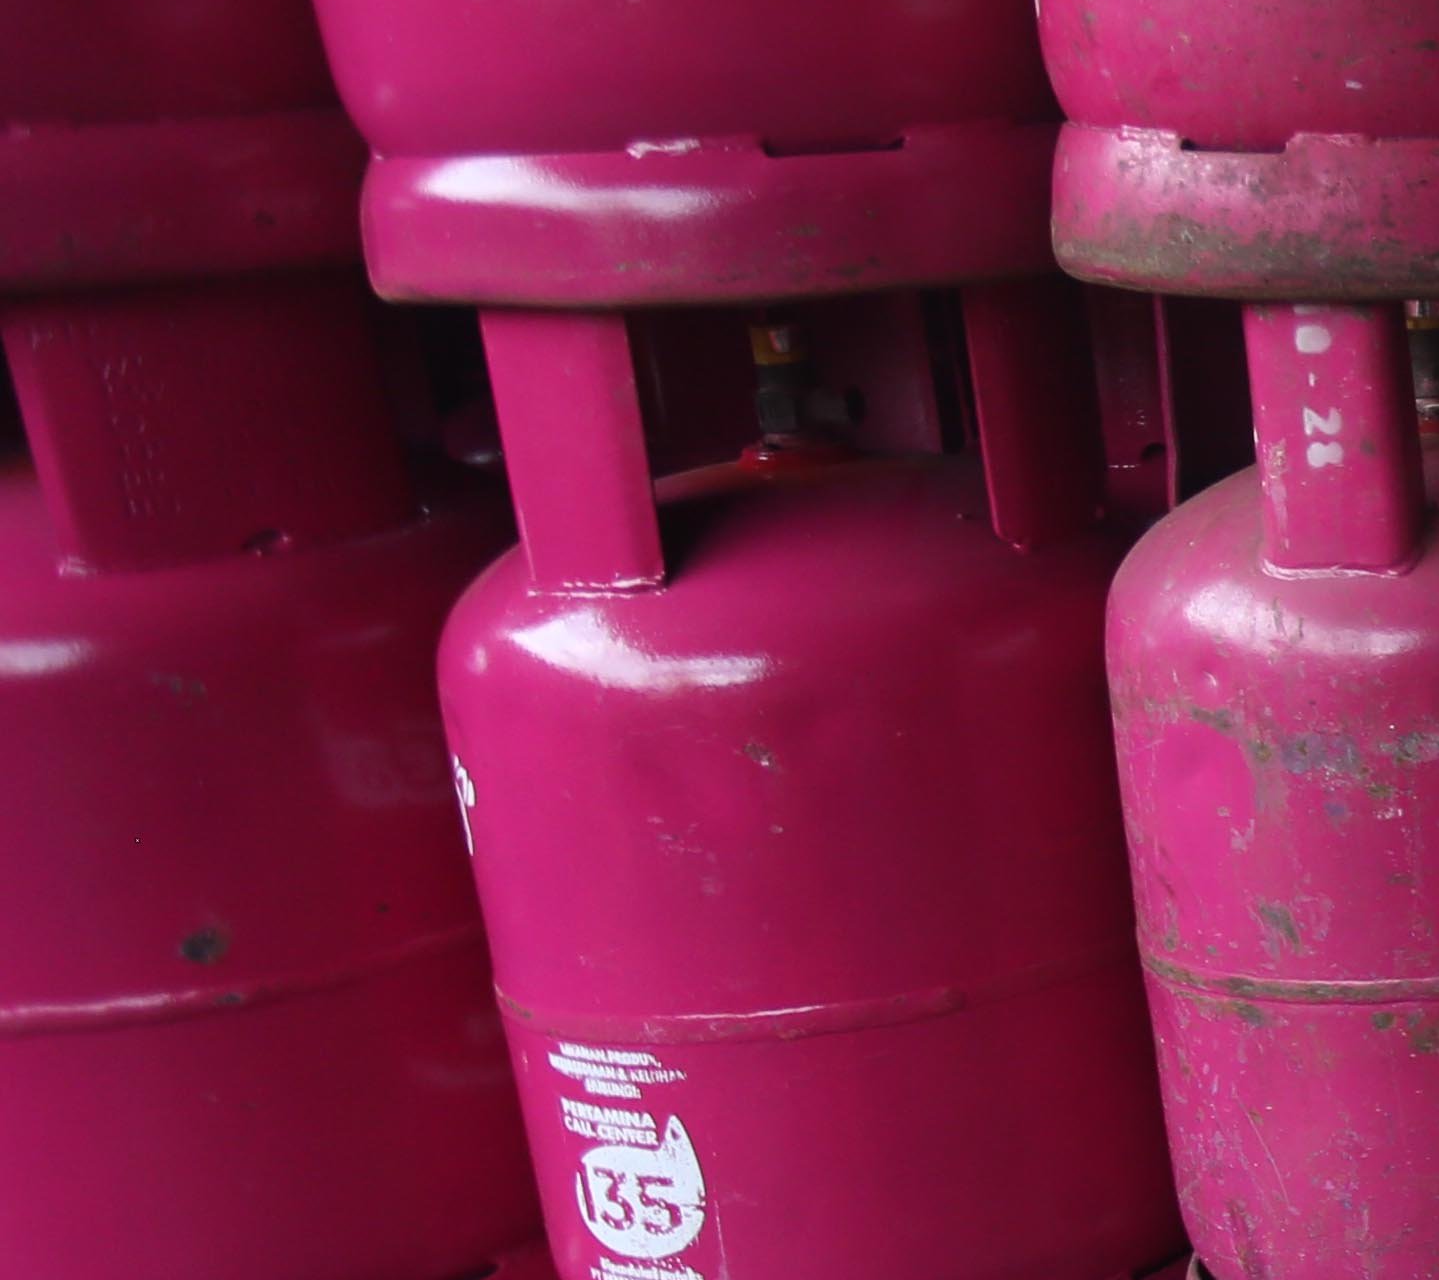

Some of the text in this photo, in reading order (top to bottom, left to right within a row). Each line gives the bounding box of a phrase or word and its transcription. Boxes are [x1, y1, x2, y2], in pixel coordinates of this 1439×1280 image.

[561, 1095, 657, 1129] PERTAMINA
[563, 1115, 660, 1147] CALL CENTER
[580, 1159, 684, 1236] 135
